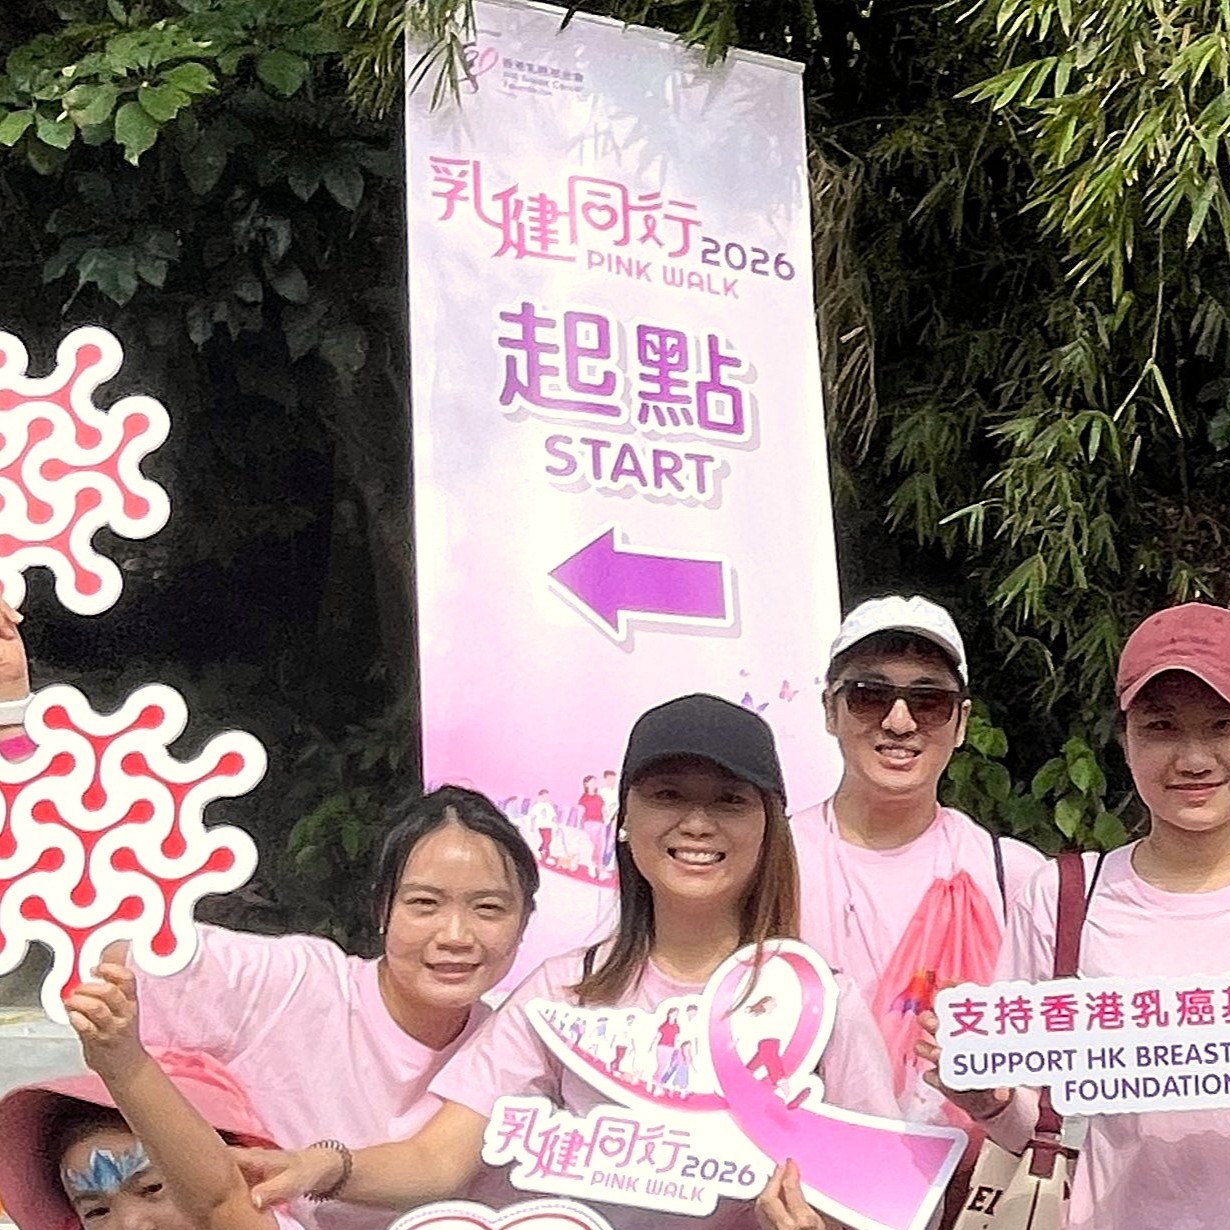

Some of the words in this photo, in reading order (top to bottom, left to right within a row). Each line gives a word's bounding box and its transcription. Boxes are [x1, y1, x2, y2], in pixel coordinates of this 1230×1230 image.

[429, 156, 703, 262] 乳健同行
[701, 237, 796, 281] 2026
[587, 249, 653, 282] PINK
[663, 266, 741, 300] WALK
[498, 302, 744, 435] 起點
[545, 434, 715, 495] START
[953, 1048, 1078, 1076] SUPPORT
[1087, 1047, 1127, 1069] HK
[498, 1107, 692, 1181] 乳健同行
[681, 1156, 755, 1186] 2026
[591, 1171, 639, 1193] PINK
[645, 1179, 706, 1203] WALK
